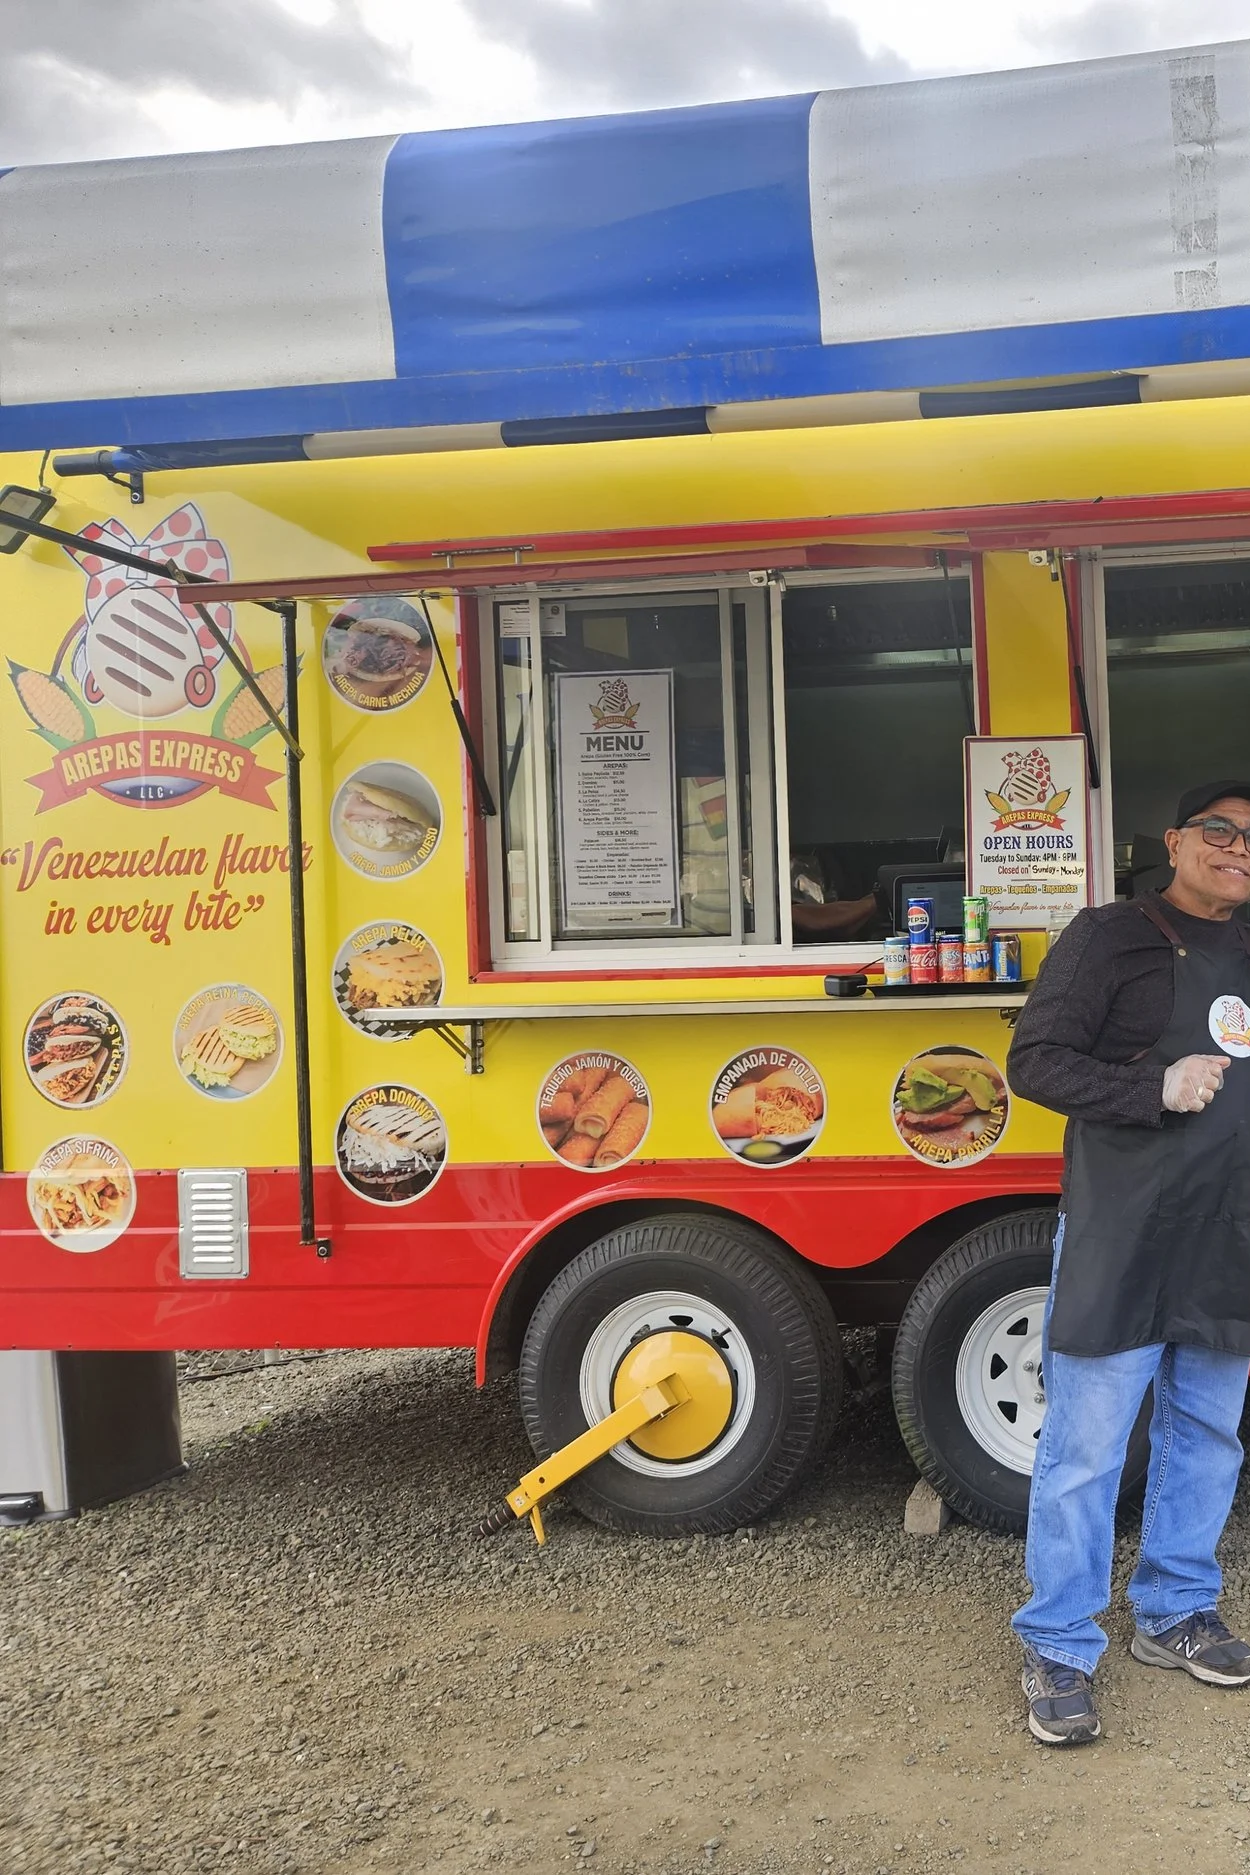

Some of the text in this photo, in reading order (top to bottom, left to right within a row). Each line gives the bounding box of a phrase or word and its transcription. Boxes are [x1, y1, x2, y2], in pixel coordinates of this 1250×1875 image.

[334, 671, 425, 708] AREPA CARNE MECHADA
[586, 735, 644, 752] MENU
[61, 739, 245, 786] AREPAS EXPRESS
[140, 786, 165, 799] LLC
[1001, 811, 1055, 825] AREPAS EXPRESS
[350, 852, 377, 874] AREPA
[410, 856, 420, 865] Y
[416, 828, 438, 860] QUESO
[984, 835, 1074, 850] OPEN HOURS
[980, 853, 1006, 864] Tuesday
[1006, 854, 1014, 862] to
[1015, 853, 1041, 863] Sunday:
[1042, 853, 1057, 862] 4PM
[998, 865, 1020, 875] Closed
[1032, 864, 1084, 877] Sunday Monday
[979, 884, 1078, 895] Arepas Tequeños Empanadas
[44, 900, 77, 935] in
[86, 899, 175, 946] every
[350, 926, 427, 952] AREPA PELUA
[180, 988, 278, 1031] AREPA REINA PEPIADA
[541, 1053, 648, 1109] TEQUEÑO JAMÓN Y QUESO
[714, 1051, 821, 1105] EMPANADA DE POLLO
[350, 1090, 388, 1117] AREPA
[910, 1105, 1005, 1163] AREPA PARRILLA
[39, 1140, 120, 1176] AREPA SIFRINA
